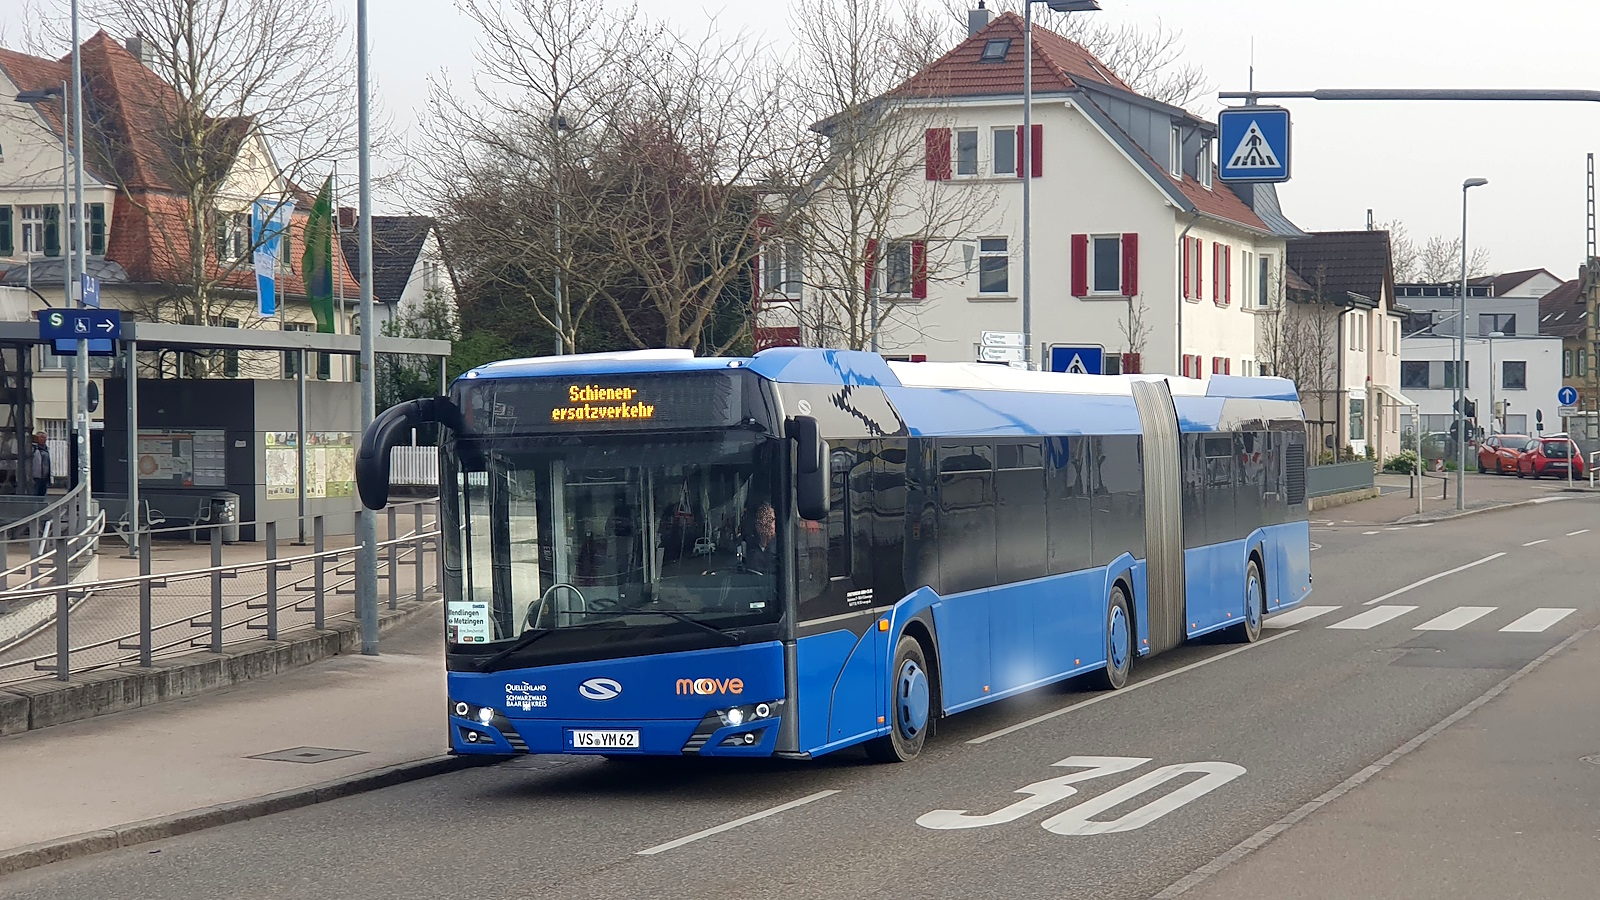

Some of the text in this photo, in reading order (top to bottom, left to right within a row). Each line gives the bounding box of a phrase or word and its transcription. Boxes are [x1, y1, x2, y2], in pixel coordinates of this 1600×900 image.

[51, 313, 62, 325] S
[569, 385, 637, 401] Schienen-
[552, 402, 654, 419] ersatzverkehr
[675, 677, 744, 695] moove
[531, 700, 548, 708] KREIS
[578, 733, 634, 746] VS YM 62
[915, 755, 1247, 836] 30
